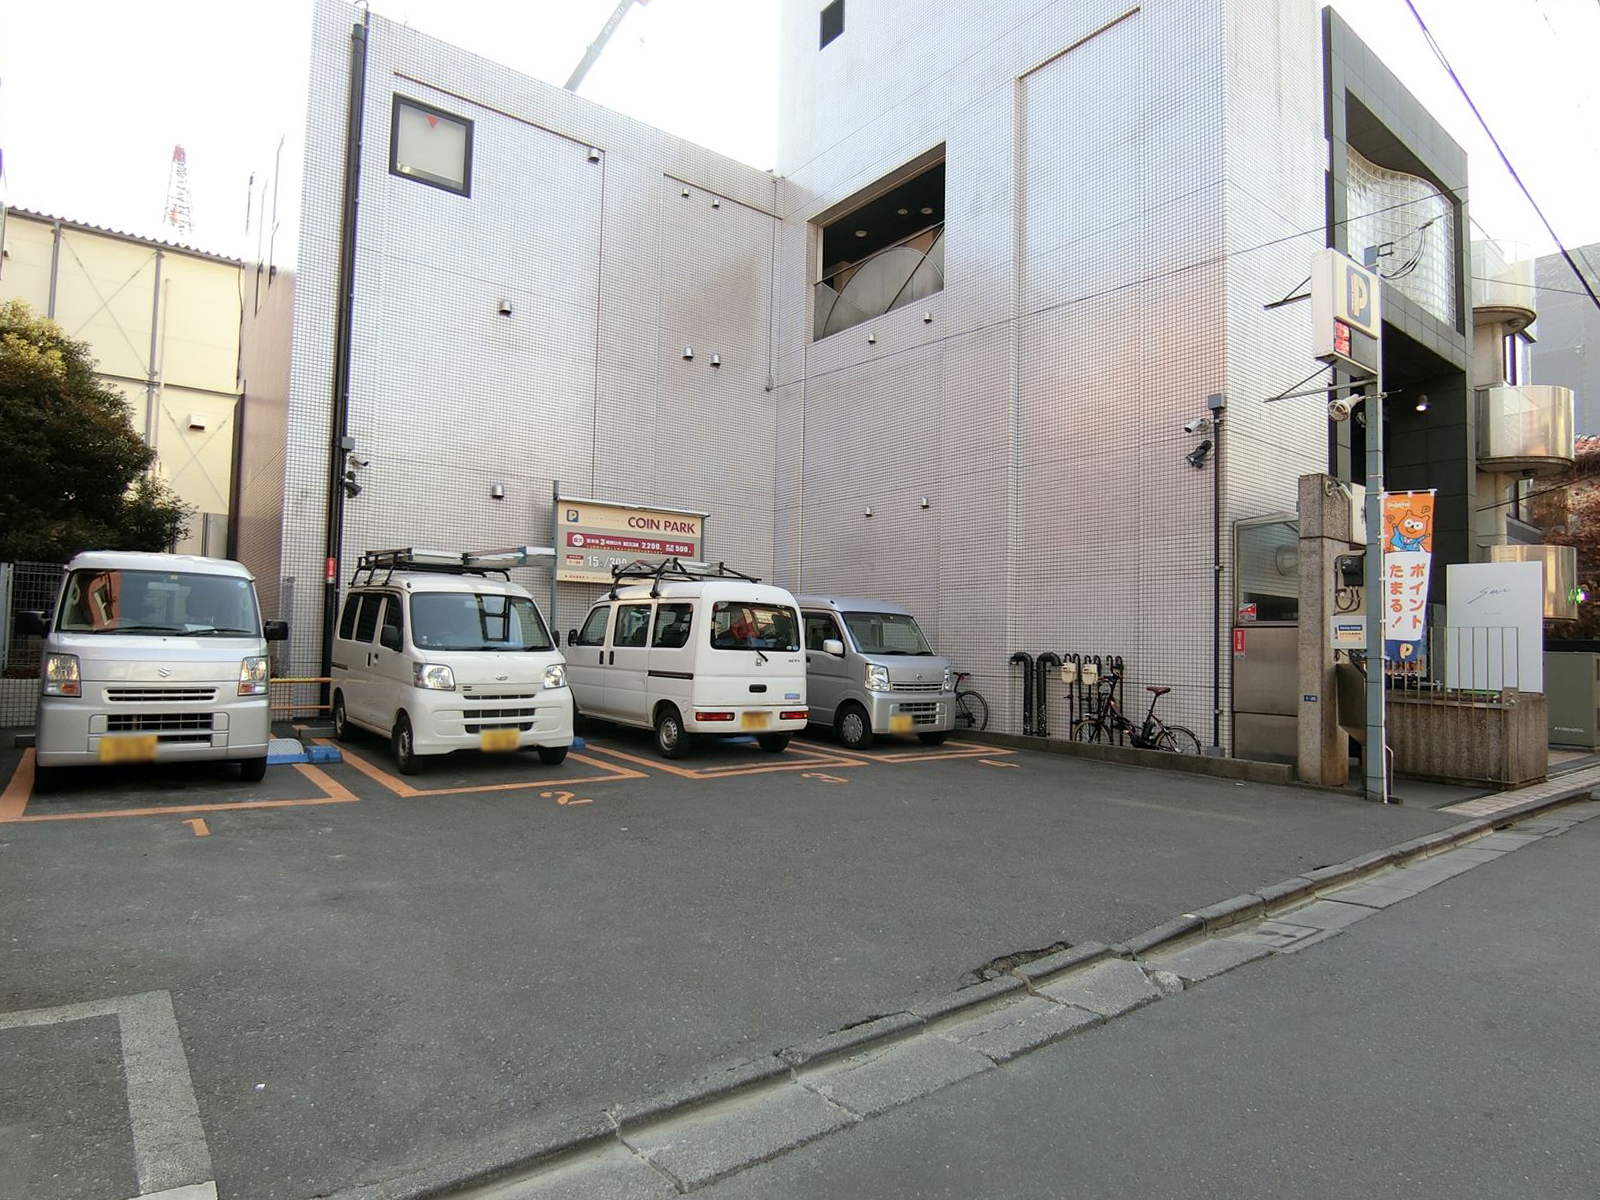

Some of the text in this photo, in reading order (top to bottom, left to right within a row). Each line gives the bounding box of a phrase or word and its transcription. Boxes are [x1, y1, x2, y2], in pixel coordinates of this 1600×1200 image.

[1350, 273, 1368, 317] P
[628, 516, 660, 530] COIN
[664, 520, 695, 533] PARK
[1409, 563, 1426, 629] ポイント
[1400, 643, 1413, 659] P
